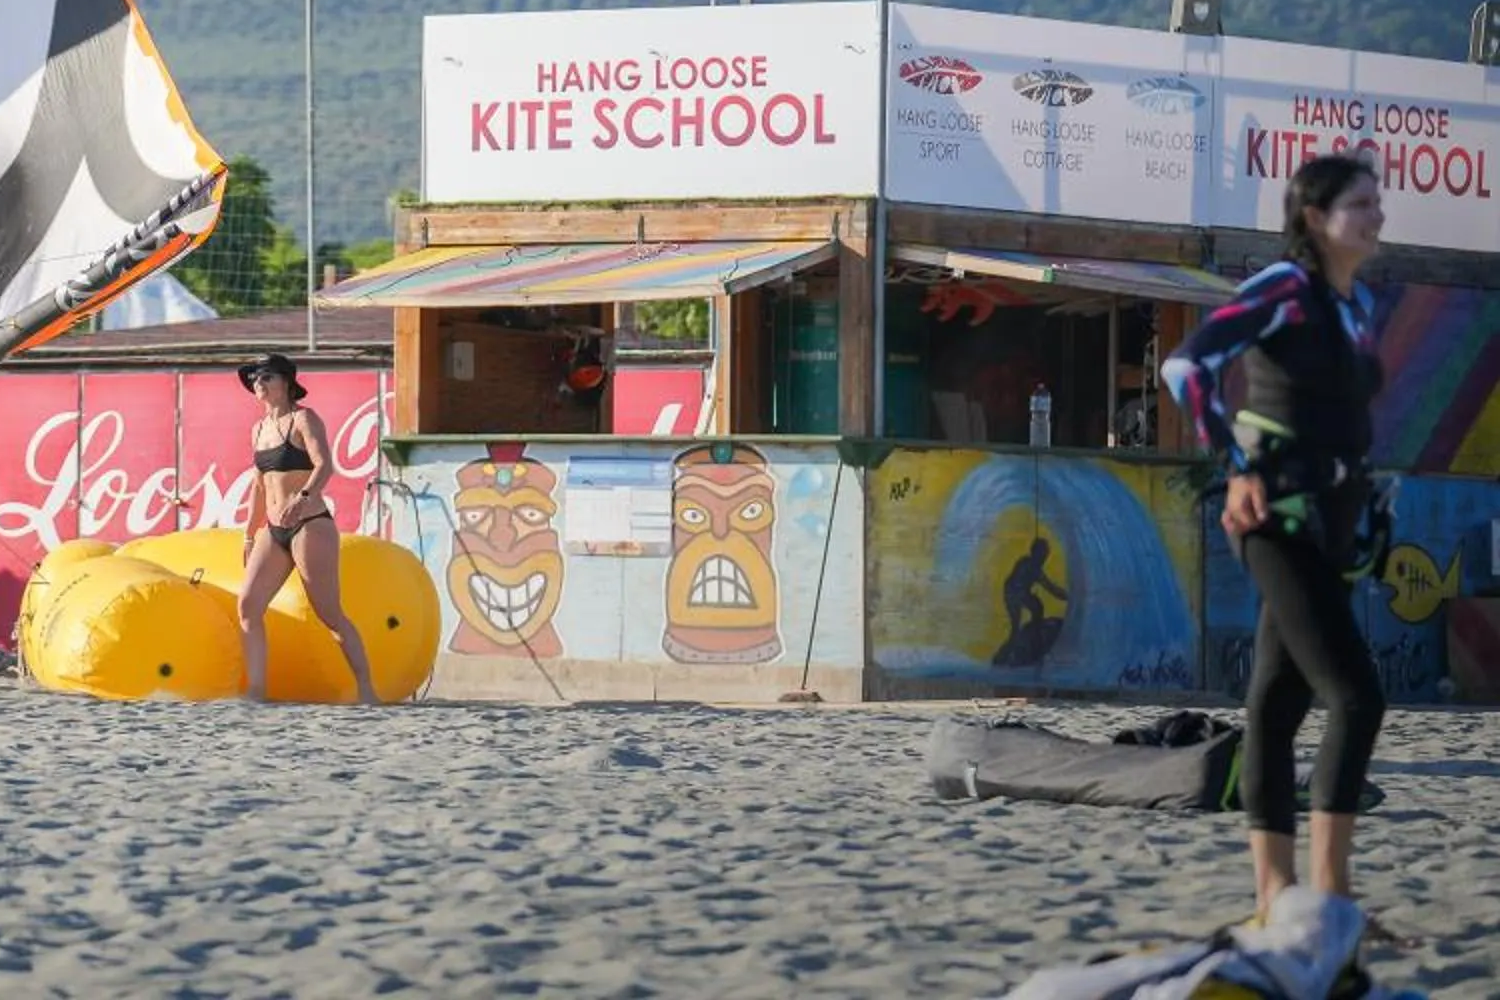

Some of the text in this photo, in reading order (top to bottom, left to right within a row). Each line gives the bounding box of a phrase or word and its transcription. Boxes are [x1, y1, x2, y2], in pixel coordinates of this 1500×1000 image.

[537, 55, 768, 93] HANG LOOSE
[470, 93, 836, 152] KITE SCHOOL
[897, 108, 983, 134] HANG LOOSE
[1293, 93, 1449, 139] HANG LOOSE
[1011, 119, 1097, 143] HANG LOOSE
[1125, 127, 1208, 154] HANG LOOSE
[919, 141, 961, 162] SPORT
[1022, 149, 1084, 172] COTTAGE
[1144, 160, 1187, 181] BEACH
